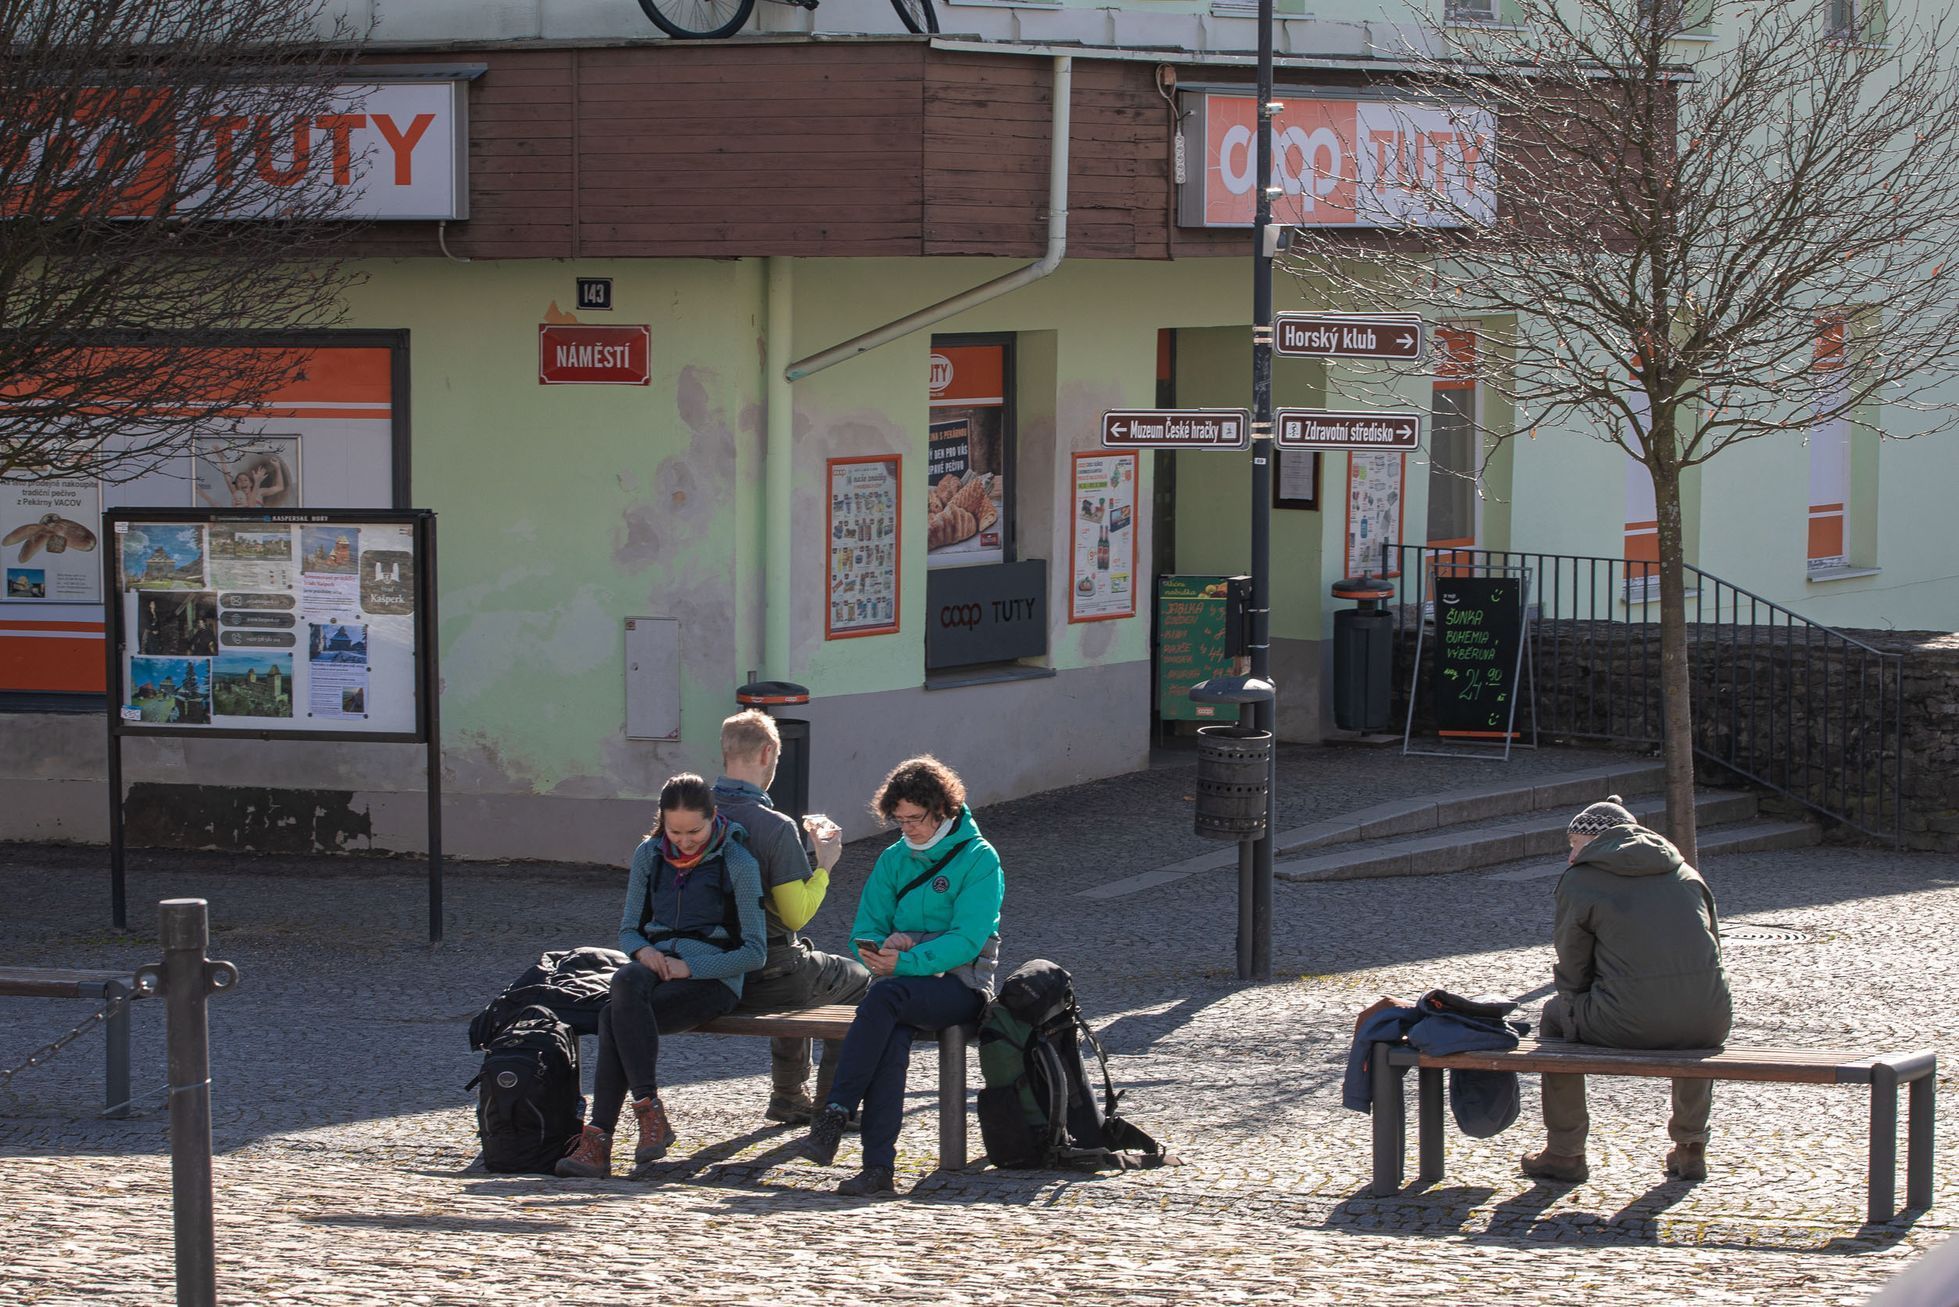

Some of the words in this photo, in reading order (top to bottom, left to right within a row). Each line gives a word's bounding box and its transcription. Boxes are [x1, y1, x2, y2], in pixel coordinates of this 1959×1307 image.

[201, 113, 436, 186] TUTY
[1369, 130, 1487, 197] TUTY
[584, 284, 604, 303] 143
[1285, 325, 1338, 353] Horský
[1343, 327, 1377, 350] klub
[556, 342, 631, 368] NÁMĚSTÍ
[1130, 420, 1163, 439] Muzeum
[1165, 417, 1190, 439] České
[1191, 420, 1219, 443] hračky
[1305, 421, 1348, 441] Zdravotní
[1350, 422, 1393, 442] středisko
[23, 498, 52, 507] Pekárny
[51, 489, 77, 497] pečivo
[371, 593, 405, 606] Kašperk
[992, 598, 1035, 623] TUTY
[1446, 608, 1484, 625] ŠUNKA
[1446, 630, 1489, 644] BOHEMIA
